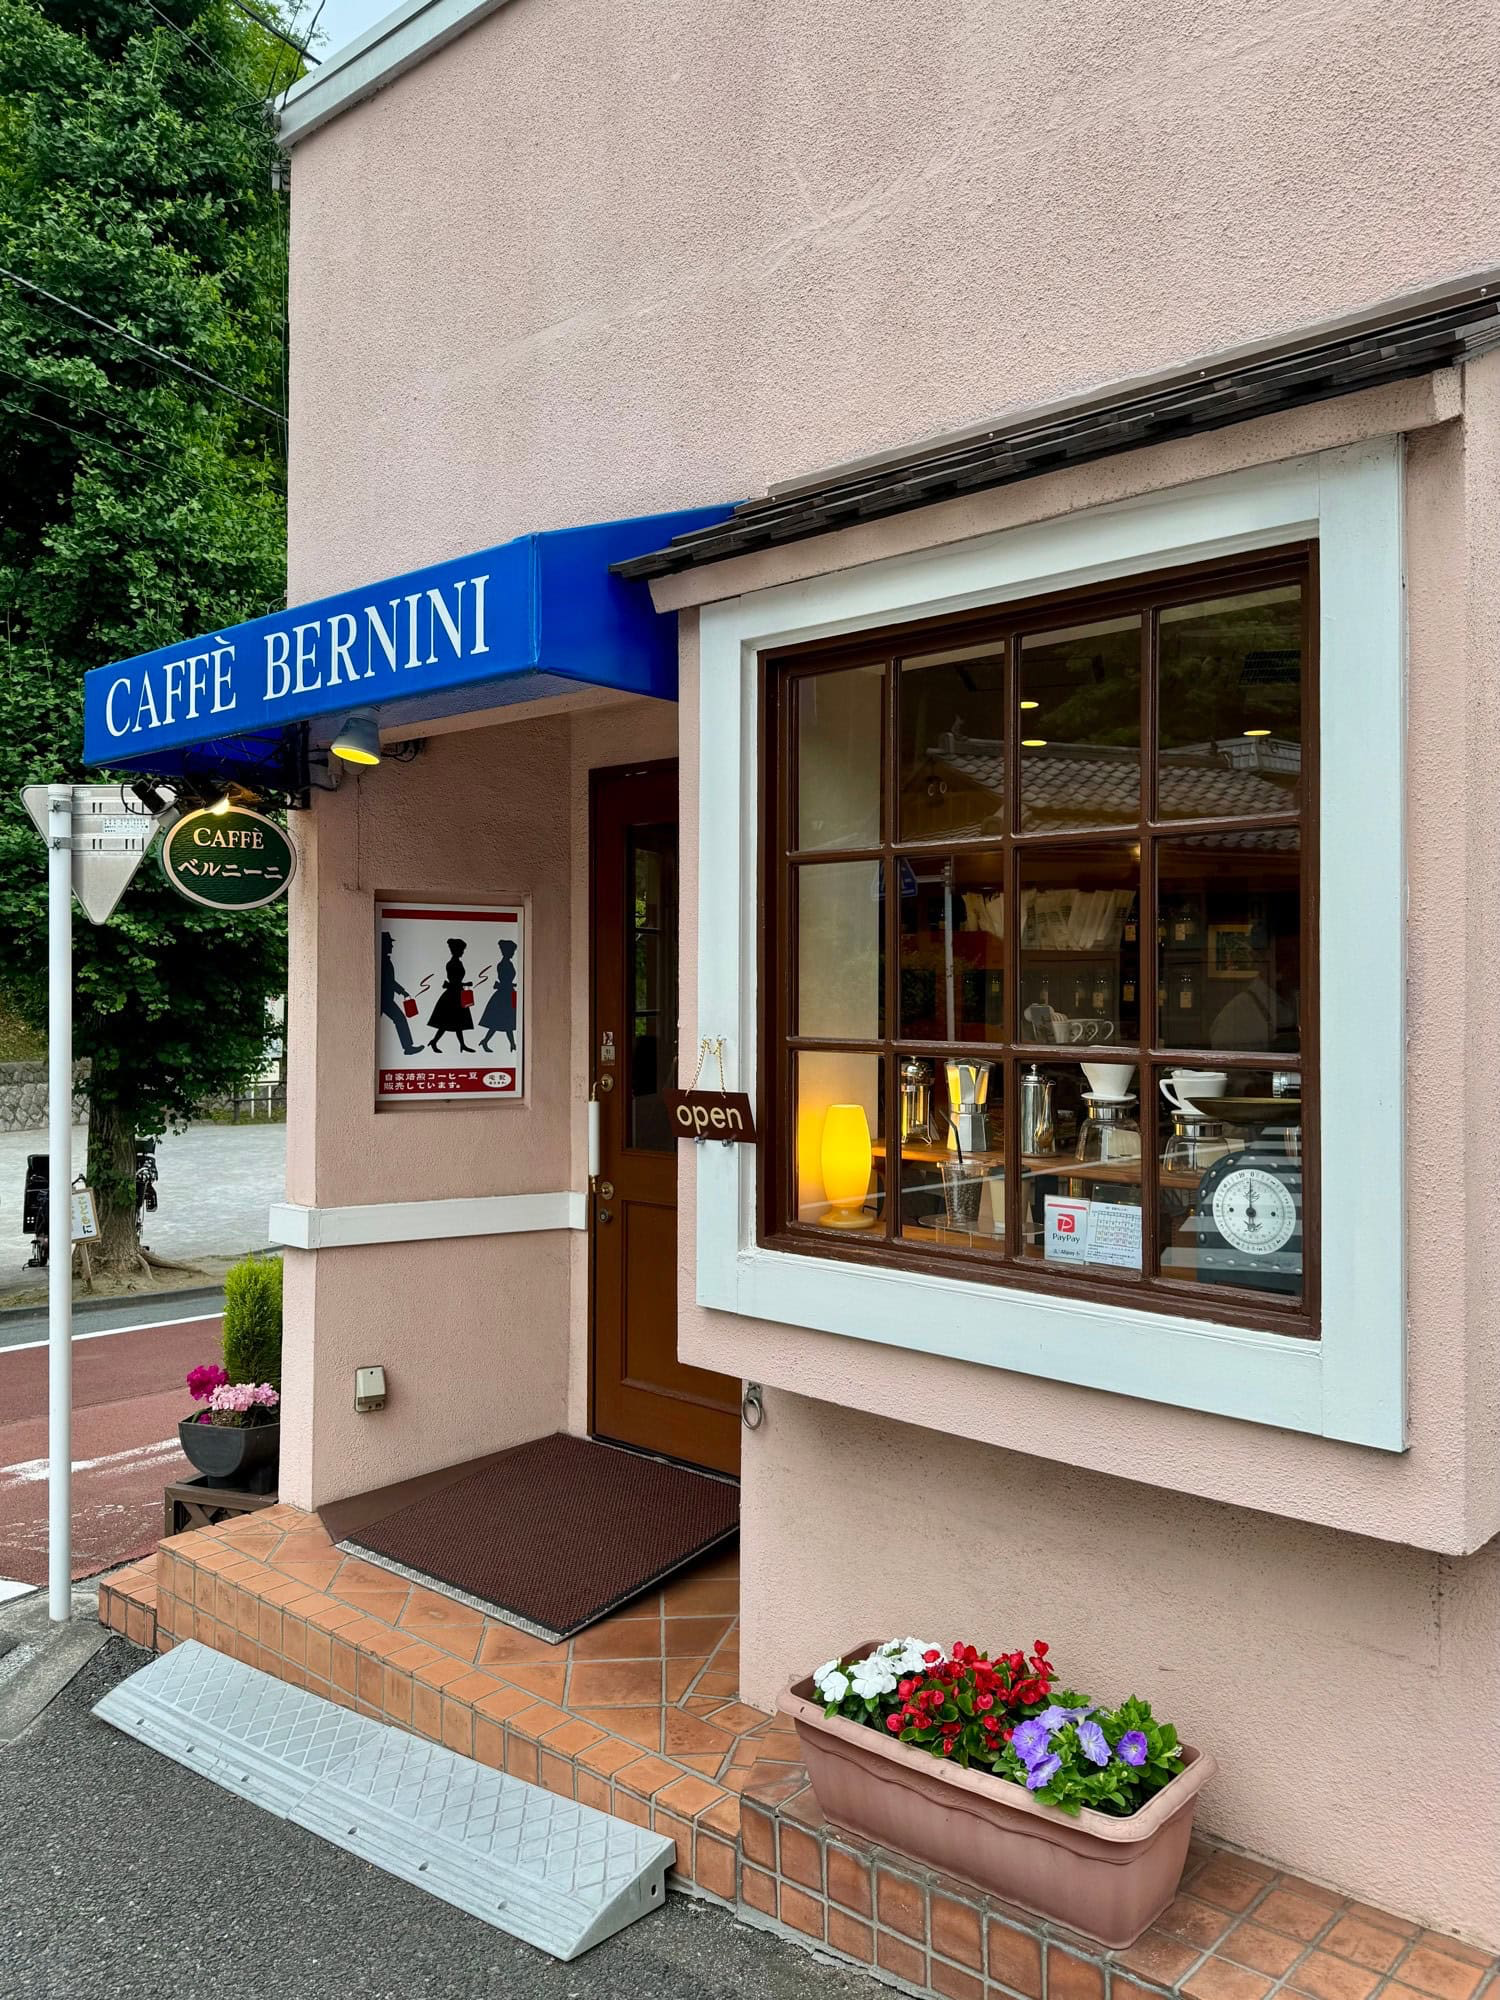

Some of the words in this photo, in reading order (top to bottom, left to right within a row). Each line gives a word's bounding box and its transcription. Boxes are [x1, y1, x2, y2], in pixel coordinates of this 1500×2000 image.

[105, 637, 236, 737] CAFFÈ
[263, 574, 490, 701] BERNINI
[193, 827, 264, 850] CAFFÈ
[177, 858, 283, 880] ベルニーニ
[676, 1105, 743, 1135] open
[1052, 1232, 1080, 1244] PayPay
